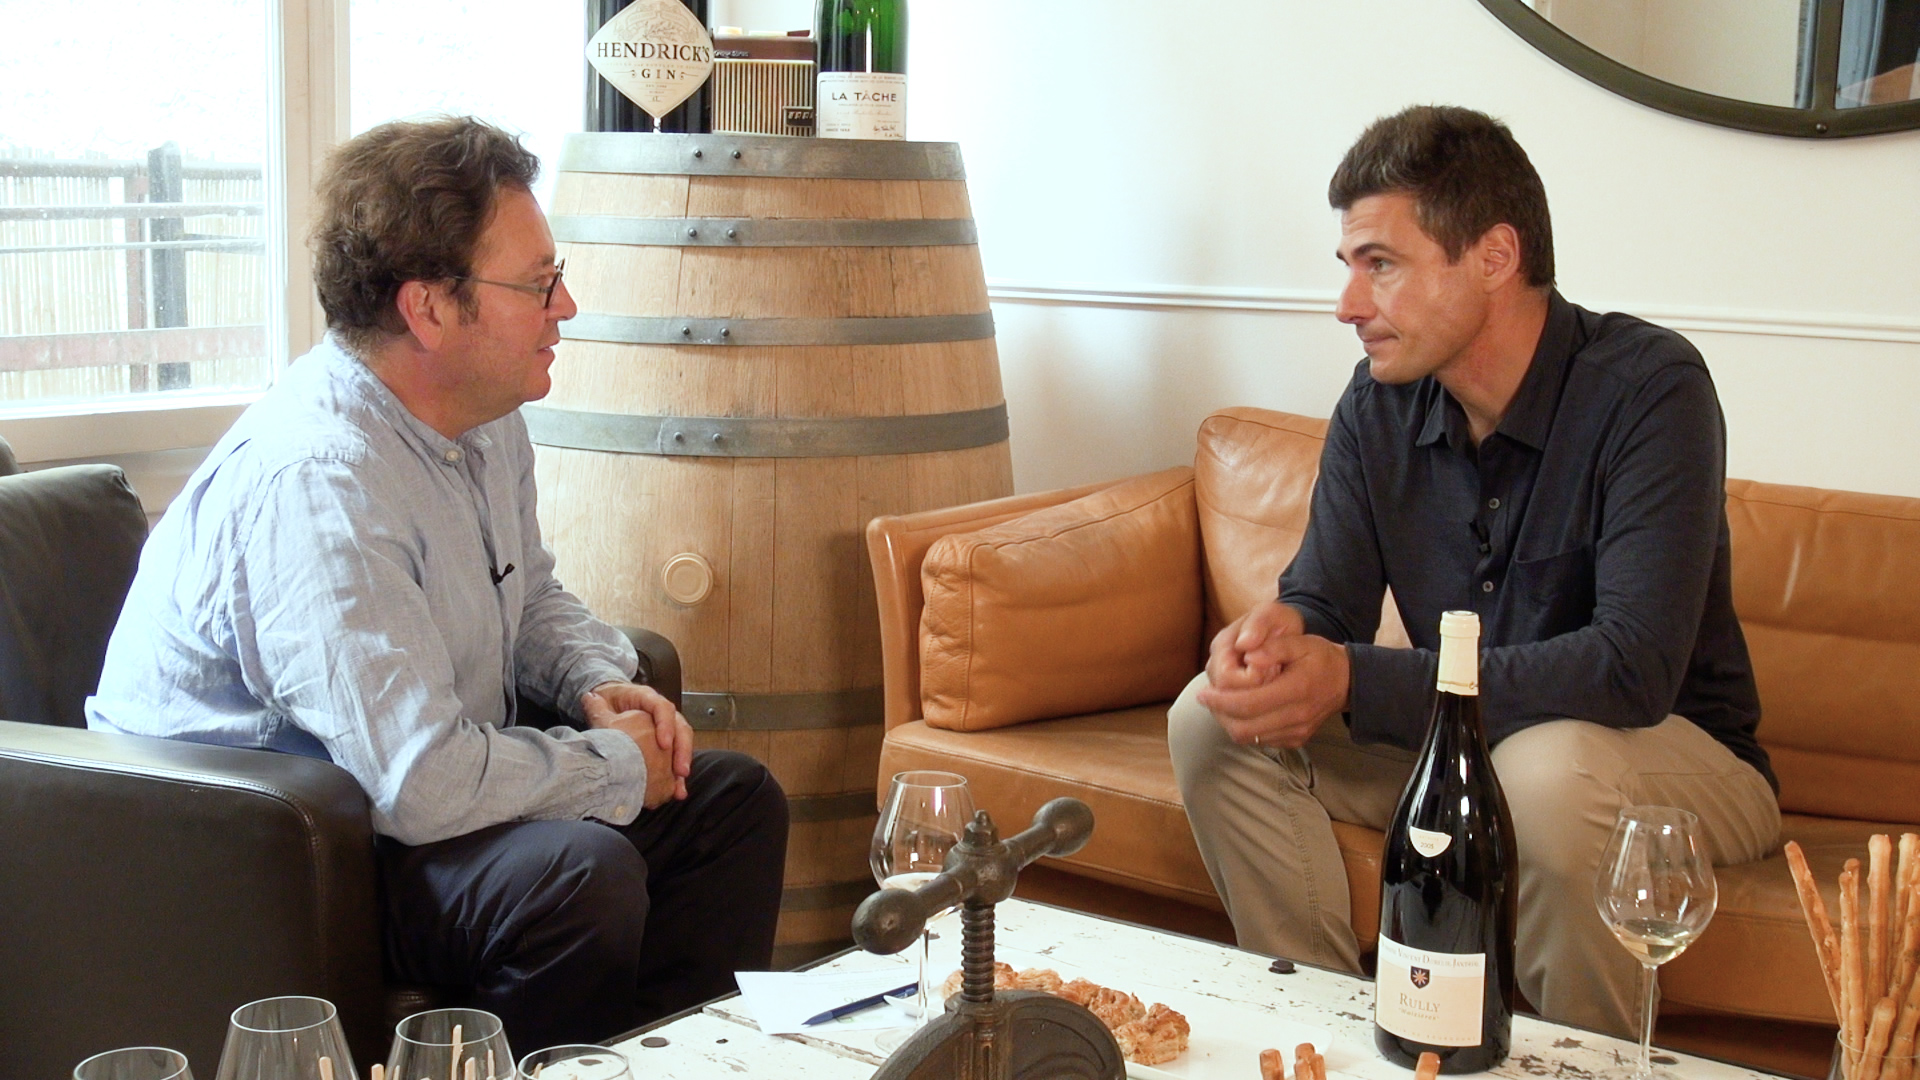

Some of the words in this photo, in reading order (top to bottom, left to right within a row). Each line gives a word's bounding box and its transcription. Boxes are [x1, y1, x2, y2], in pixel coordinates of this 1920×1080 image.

[597, 42, 711, 63] HENDRICK'S
[641, 68, 677, 80] GIN
[831, 92, 848, 101] LA
[854, 90, 897, 102] TÂCHE
[1400, 992, 1441, 1013] RULLY
